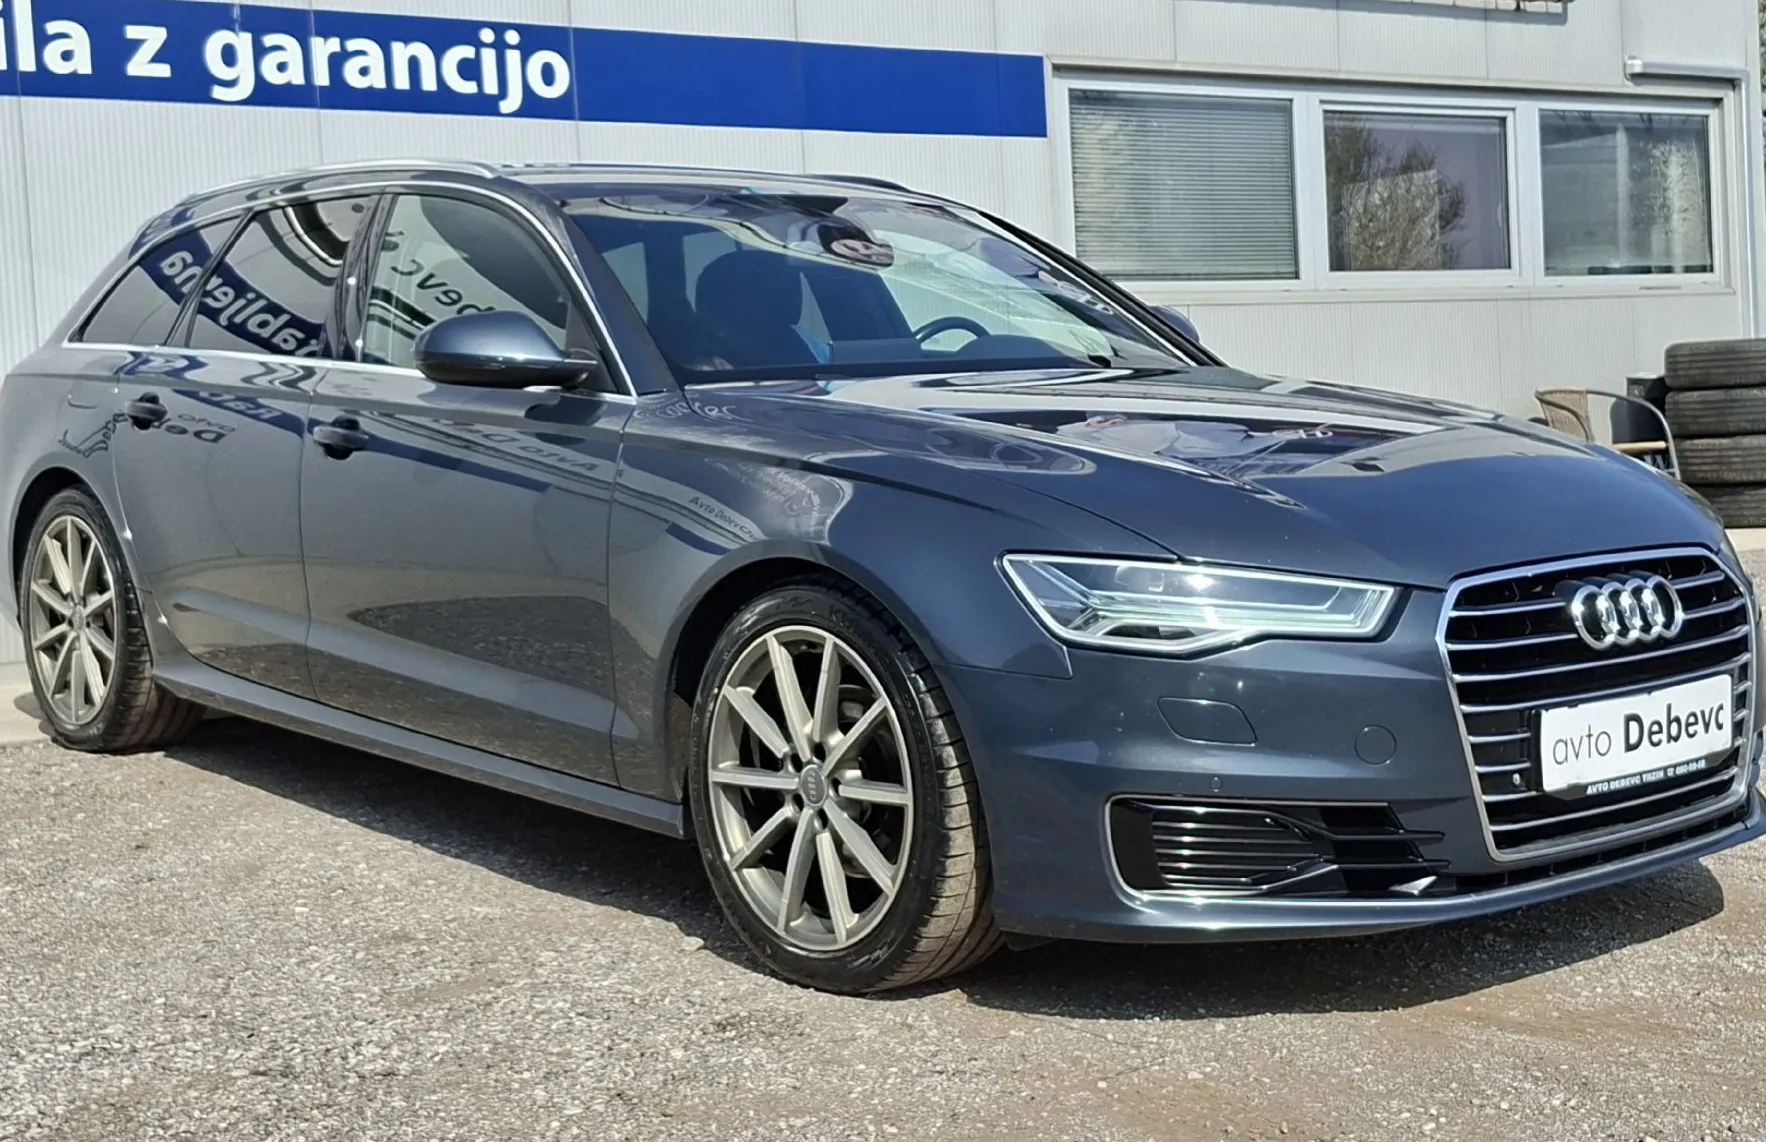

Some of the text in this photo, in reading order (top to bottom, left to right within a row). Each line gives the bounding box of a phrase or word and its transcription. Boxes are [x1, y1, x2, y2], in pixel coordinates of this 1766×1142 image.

[124, 26, 171, 77] z
[204, 28, 571, 114] garancijo
[1553, 702, 1725, 765] avto Debevc
[1586, 781, 1610, 796] AVTO
[1609, 774, 1641, 791] DEBEVC
